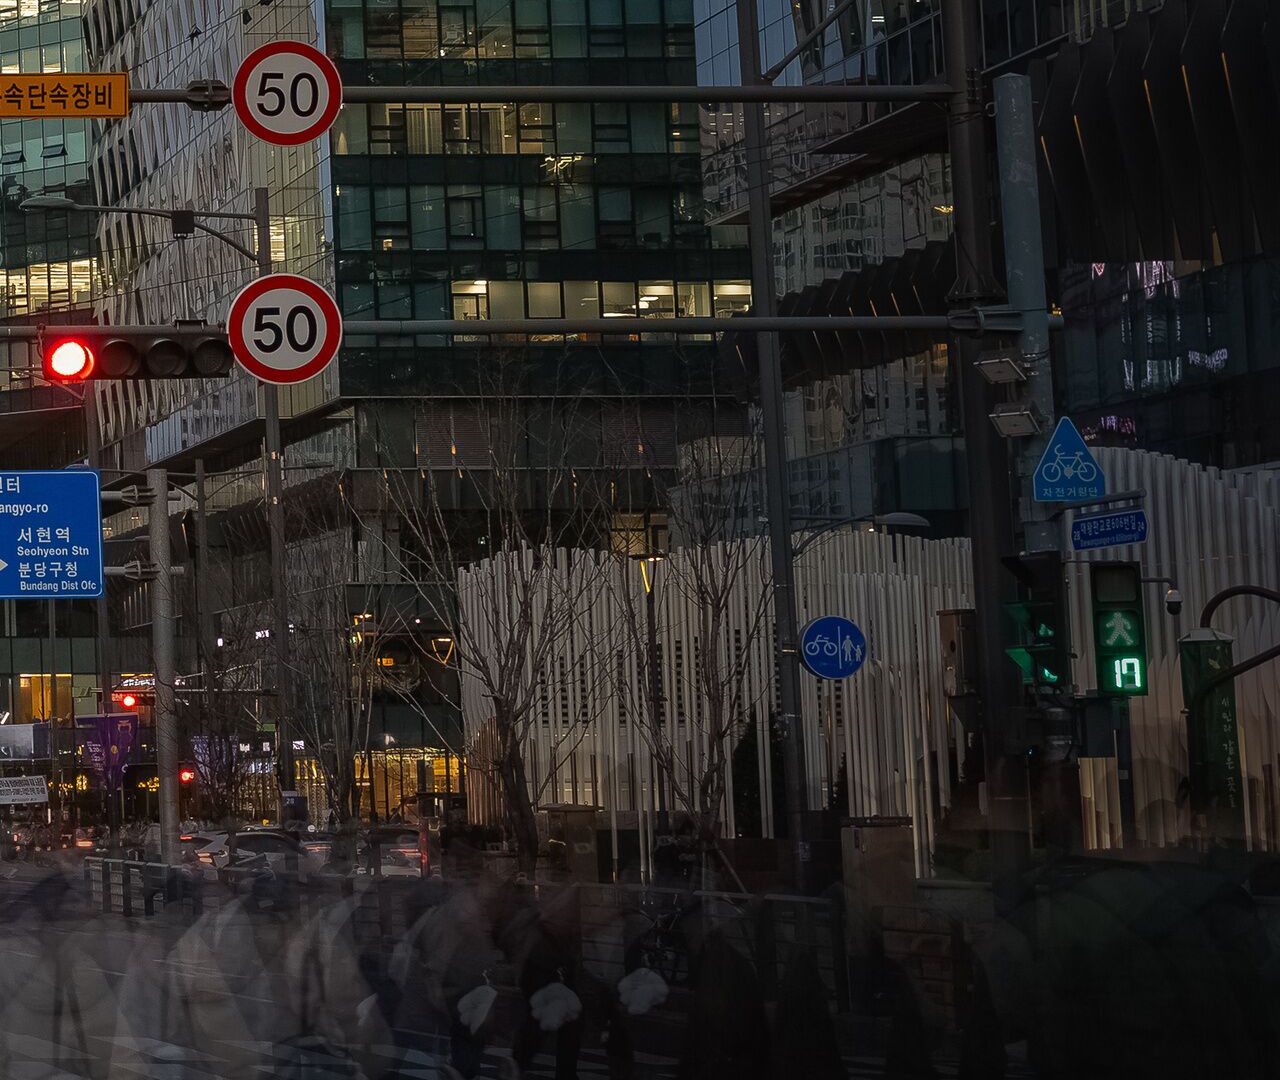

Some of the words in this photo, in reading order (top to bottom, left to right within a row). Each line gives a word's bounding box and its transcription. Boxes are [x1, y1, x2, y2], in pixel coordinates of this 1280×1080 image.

[255, 71, 320, 118] 50
[252, 305, 318, 354] 50
[18, 527, 70, 543] 서현역
[18, 547, 68, 558] Seohyeon
[72, 546, 90, 556] Stn
[18, 562, 78, 578] 분당구청
[20, 581, 59, 593] Bundang
[61, 580, 79, 591] Dist
[81, 580, 97, 590] Ofc
[1114, 657, 1141, 688] 17
